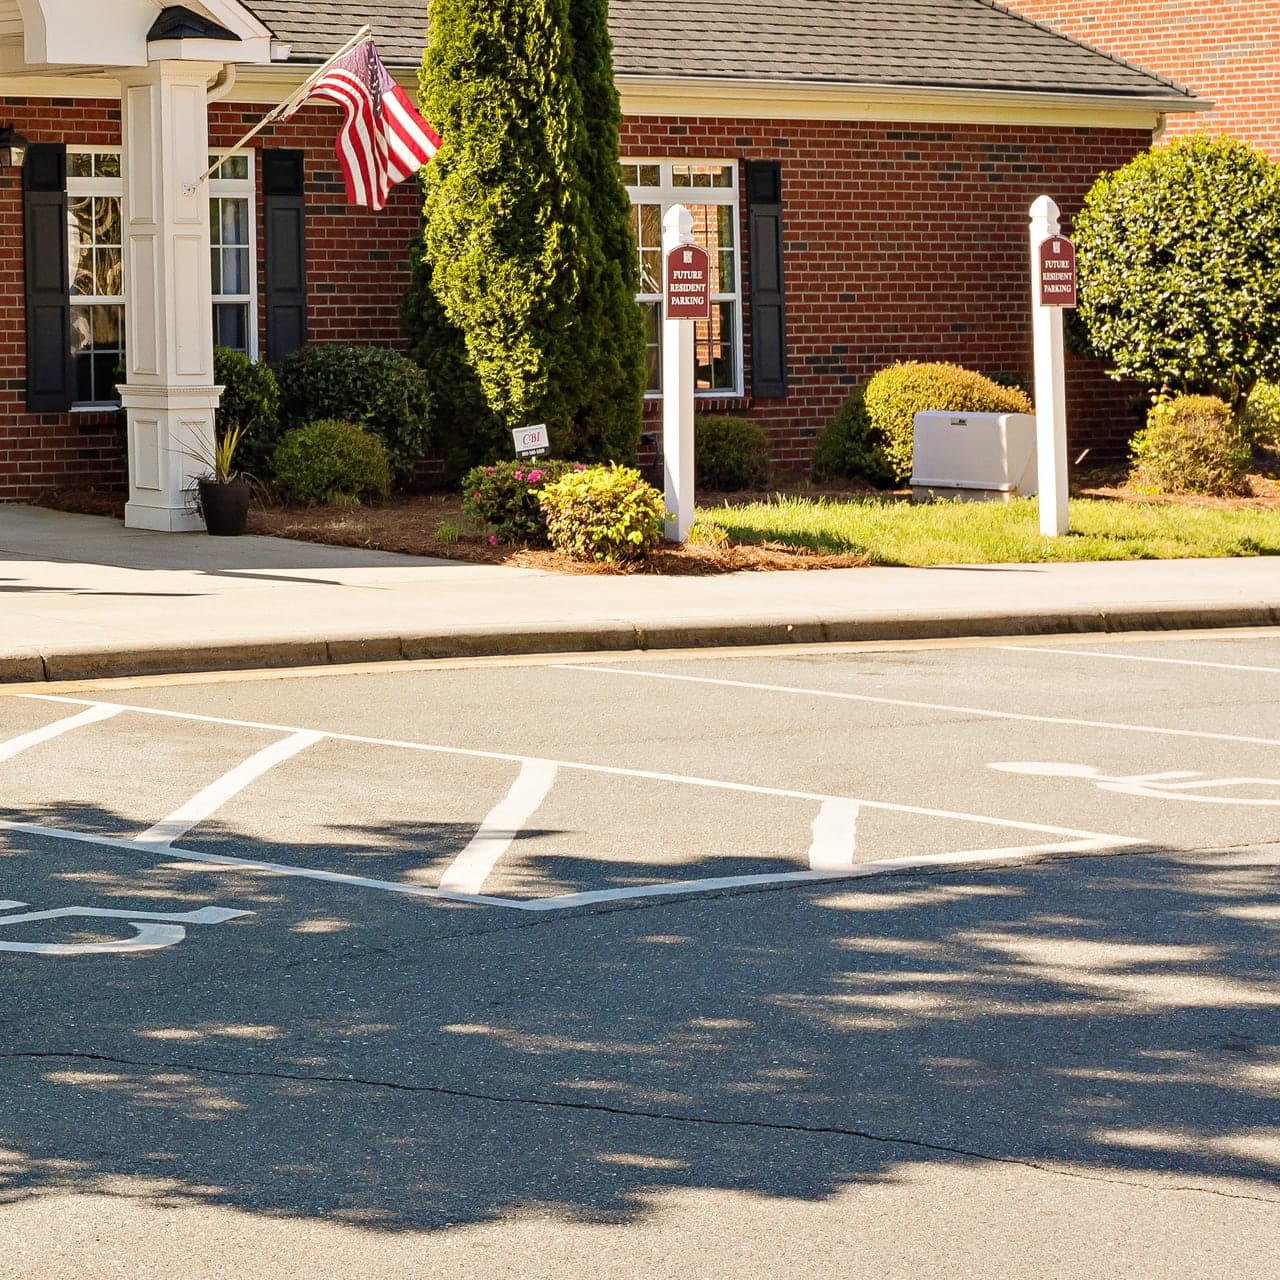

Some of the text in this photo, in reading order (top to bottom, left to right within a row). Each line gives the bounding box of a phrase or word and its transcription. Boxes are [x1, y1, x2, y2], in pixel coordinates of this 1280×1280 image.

[673, 271, 702, 279] FUTURE
[670, 284, 705, 292] RESIDENT
[1044, 285, 1071, 293] PARKING
